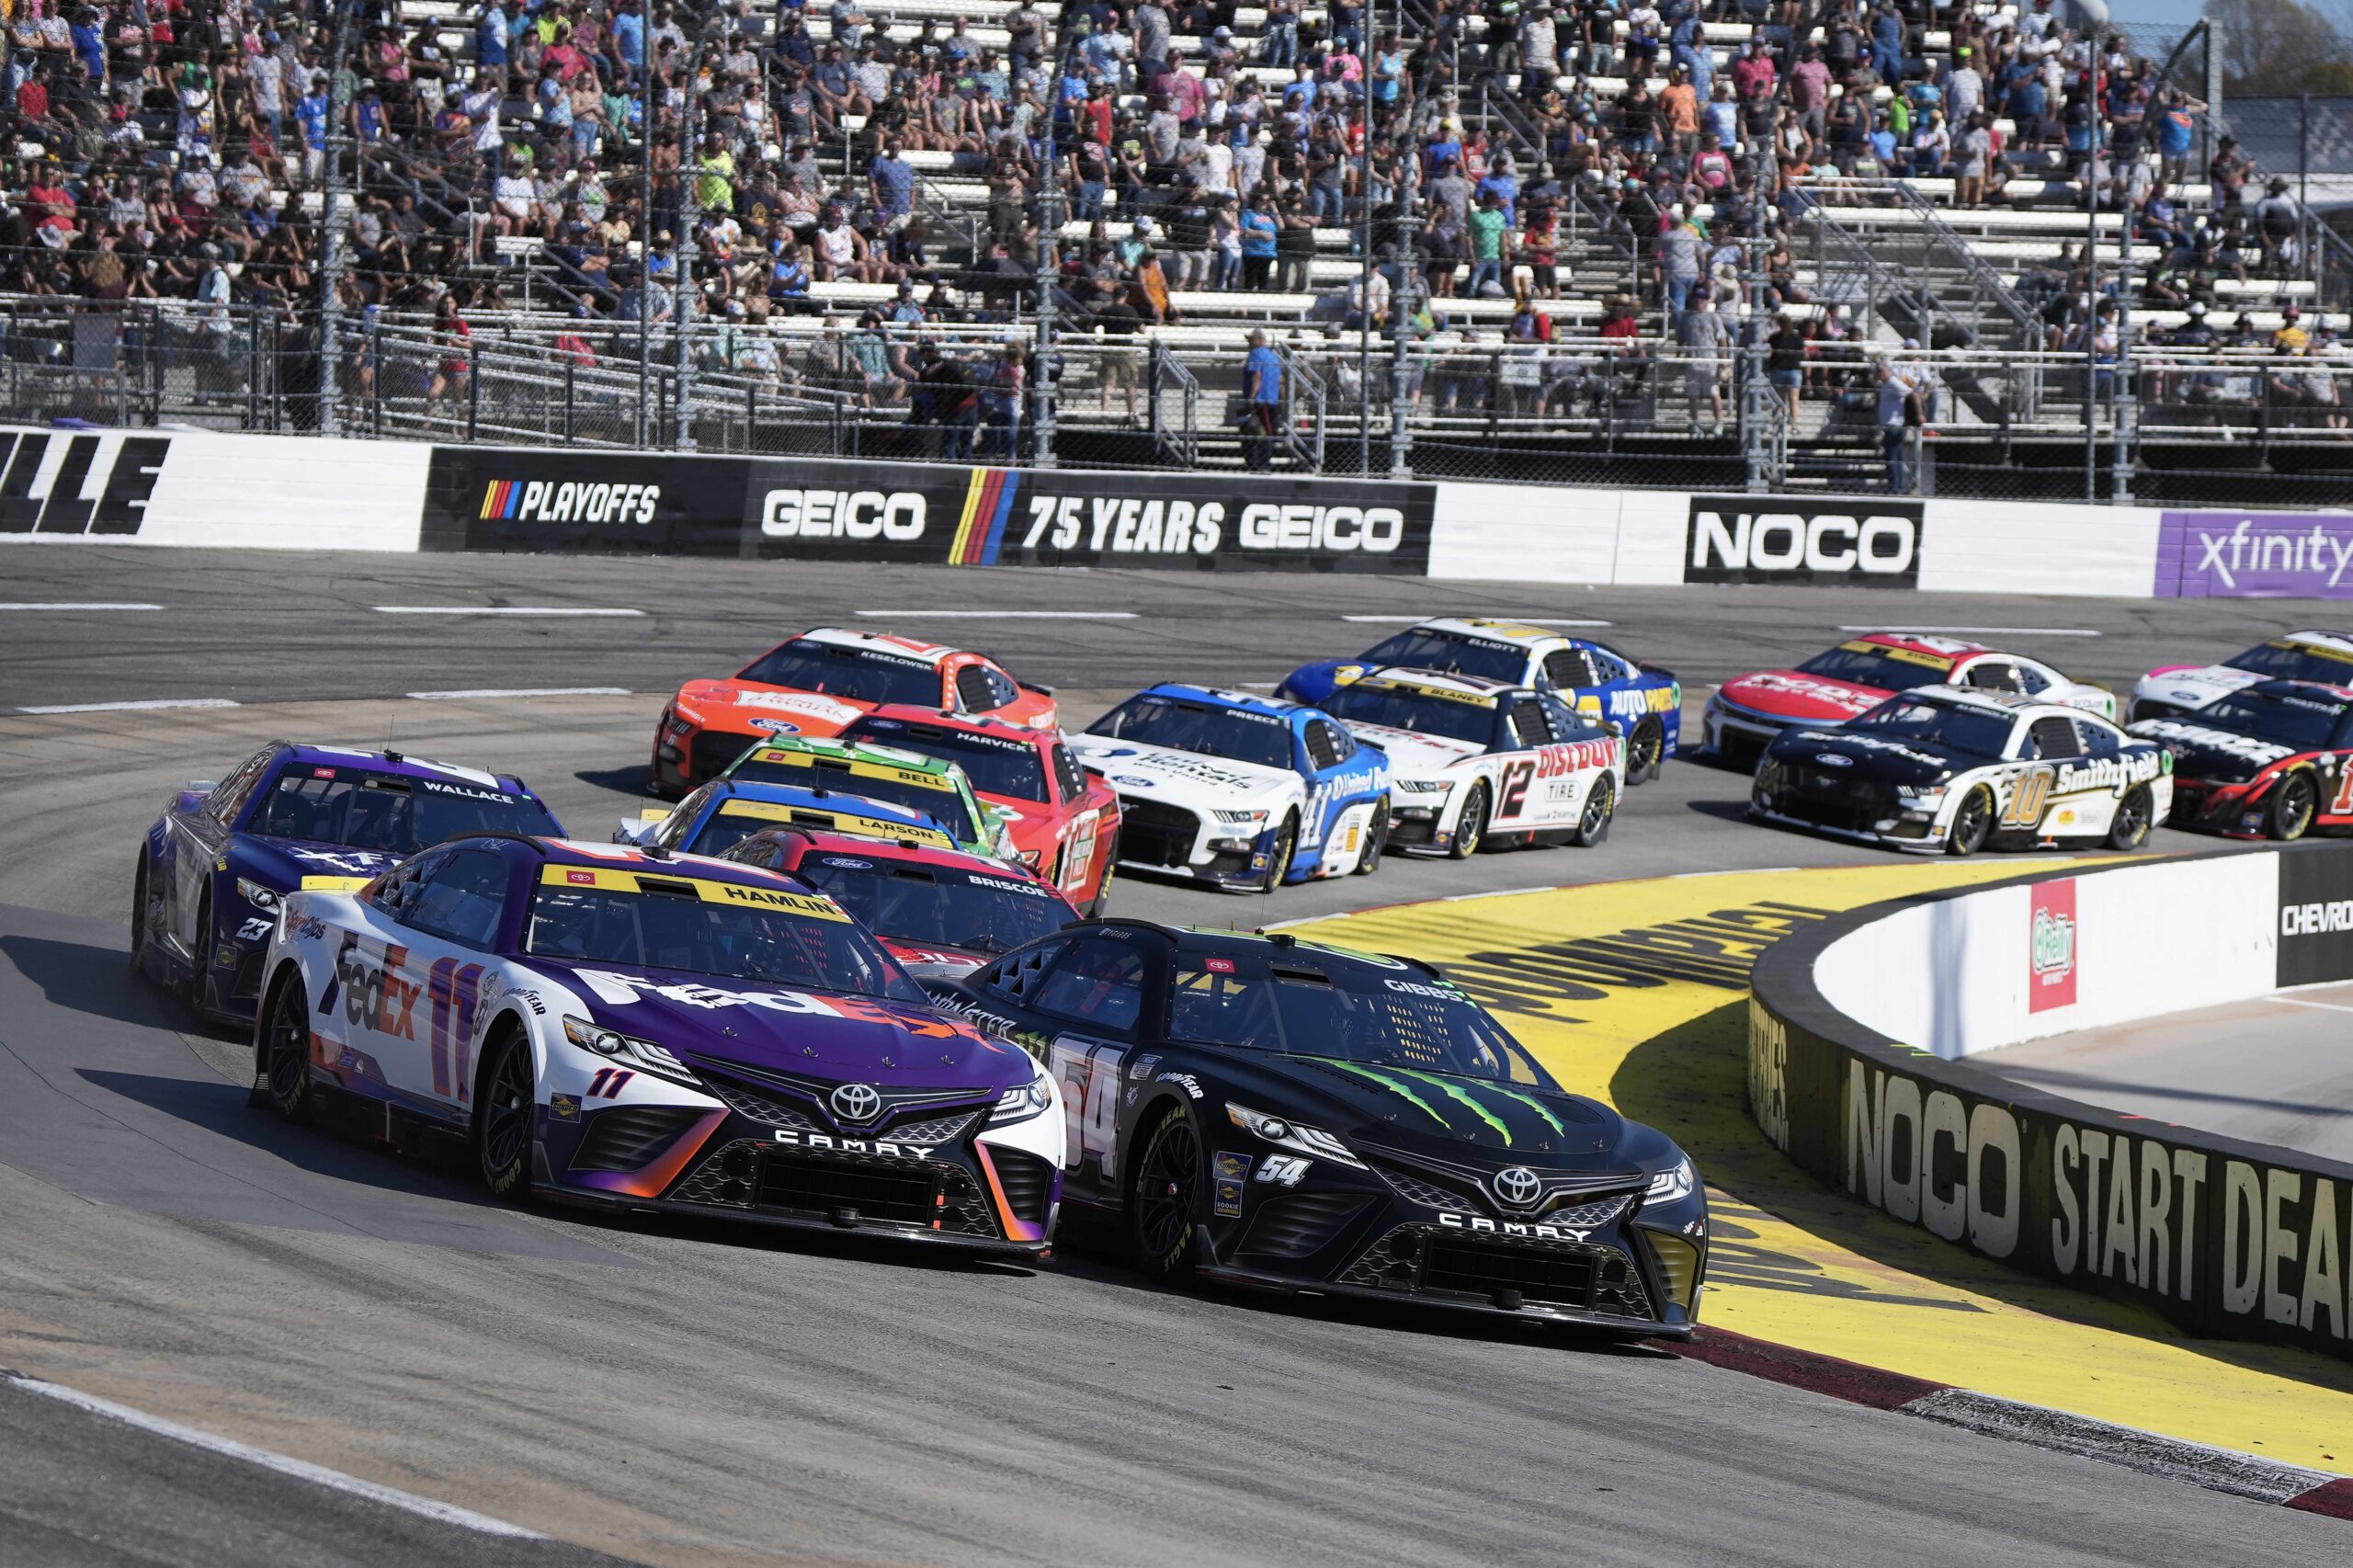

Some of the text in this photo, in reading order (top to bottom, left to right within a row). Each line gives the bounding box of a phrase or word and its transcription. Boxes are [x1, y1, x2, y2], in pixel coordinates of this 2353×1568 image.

[0, 432, 172, 535] LLE
[519, 481, 660, 524] PLAYOFFS
[761, 489, 926, 540] GEICO
[1023, 496, 1222, 552] 75 YEARS
[1239, 504, 1404, 551] GEICO
[1693, 511, 1915, 574] NOCO
[2198, 519, 2353, 588] xfinity
[859, 650, 934, 671] KESELOWSK
[1468, 639, 1518, 653] ELLIOTT
[1430, 688, 1484, 703] BLANEY
[1609, 689, 1647, 715] AUTO
[1226, 709, 1279, 725] PREECE
[957, 733, 1027, 753] HARVICK
[898, 769, 945, 788] BELL
[2055, 750, 2160, 799] Smithfield
[423, 781, 514, 804] WALLACE
[1495, 760, 1536, 820] 12
[1550, 784, 1574, 799] TIRE
[2001, 764, 2056, 830] 10
[859, 819, 934, 840] LARSON
[724, 887, 836, 915] HAMLIN
[968, 875, 1049, 898] BRISCOE
[235, 917, 274, 941] 23
[2281, 900, 2353, 936] CHEVRO
[318, 930, 423, 1041] FedEx
[1383, 979, 1463, 1003] GIBBS
[503, 988, 546, 1015] GOODYEAR
[427, 956, 486, 1103] 11
[585, 1067, 636, 1099] 11
[1155, 1072, 1204, 1099] GOODYEAR
[551, 1102, 579, 1113] SUNOCO
[775, 1130, 934, 1159] CAMRY
[1847, 1057, 2021, 1259] NOCO
[1217, 1161, 1245, 1173] SUNOCO
[1254, 1153, 1313, 1187] 54
[1217, 1201, 1239, 1210] ROOKIE
[1439, 1212, 1592, 1242] CAMRY
[2052, 1122, 2208, 1302] START
[2222, 1159, 2353, 1342] DEA
[1163, 1221, 1192, 1272] EAGLE
